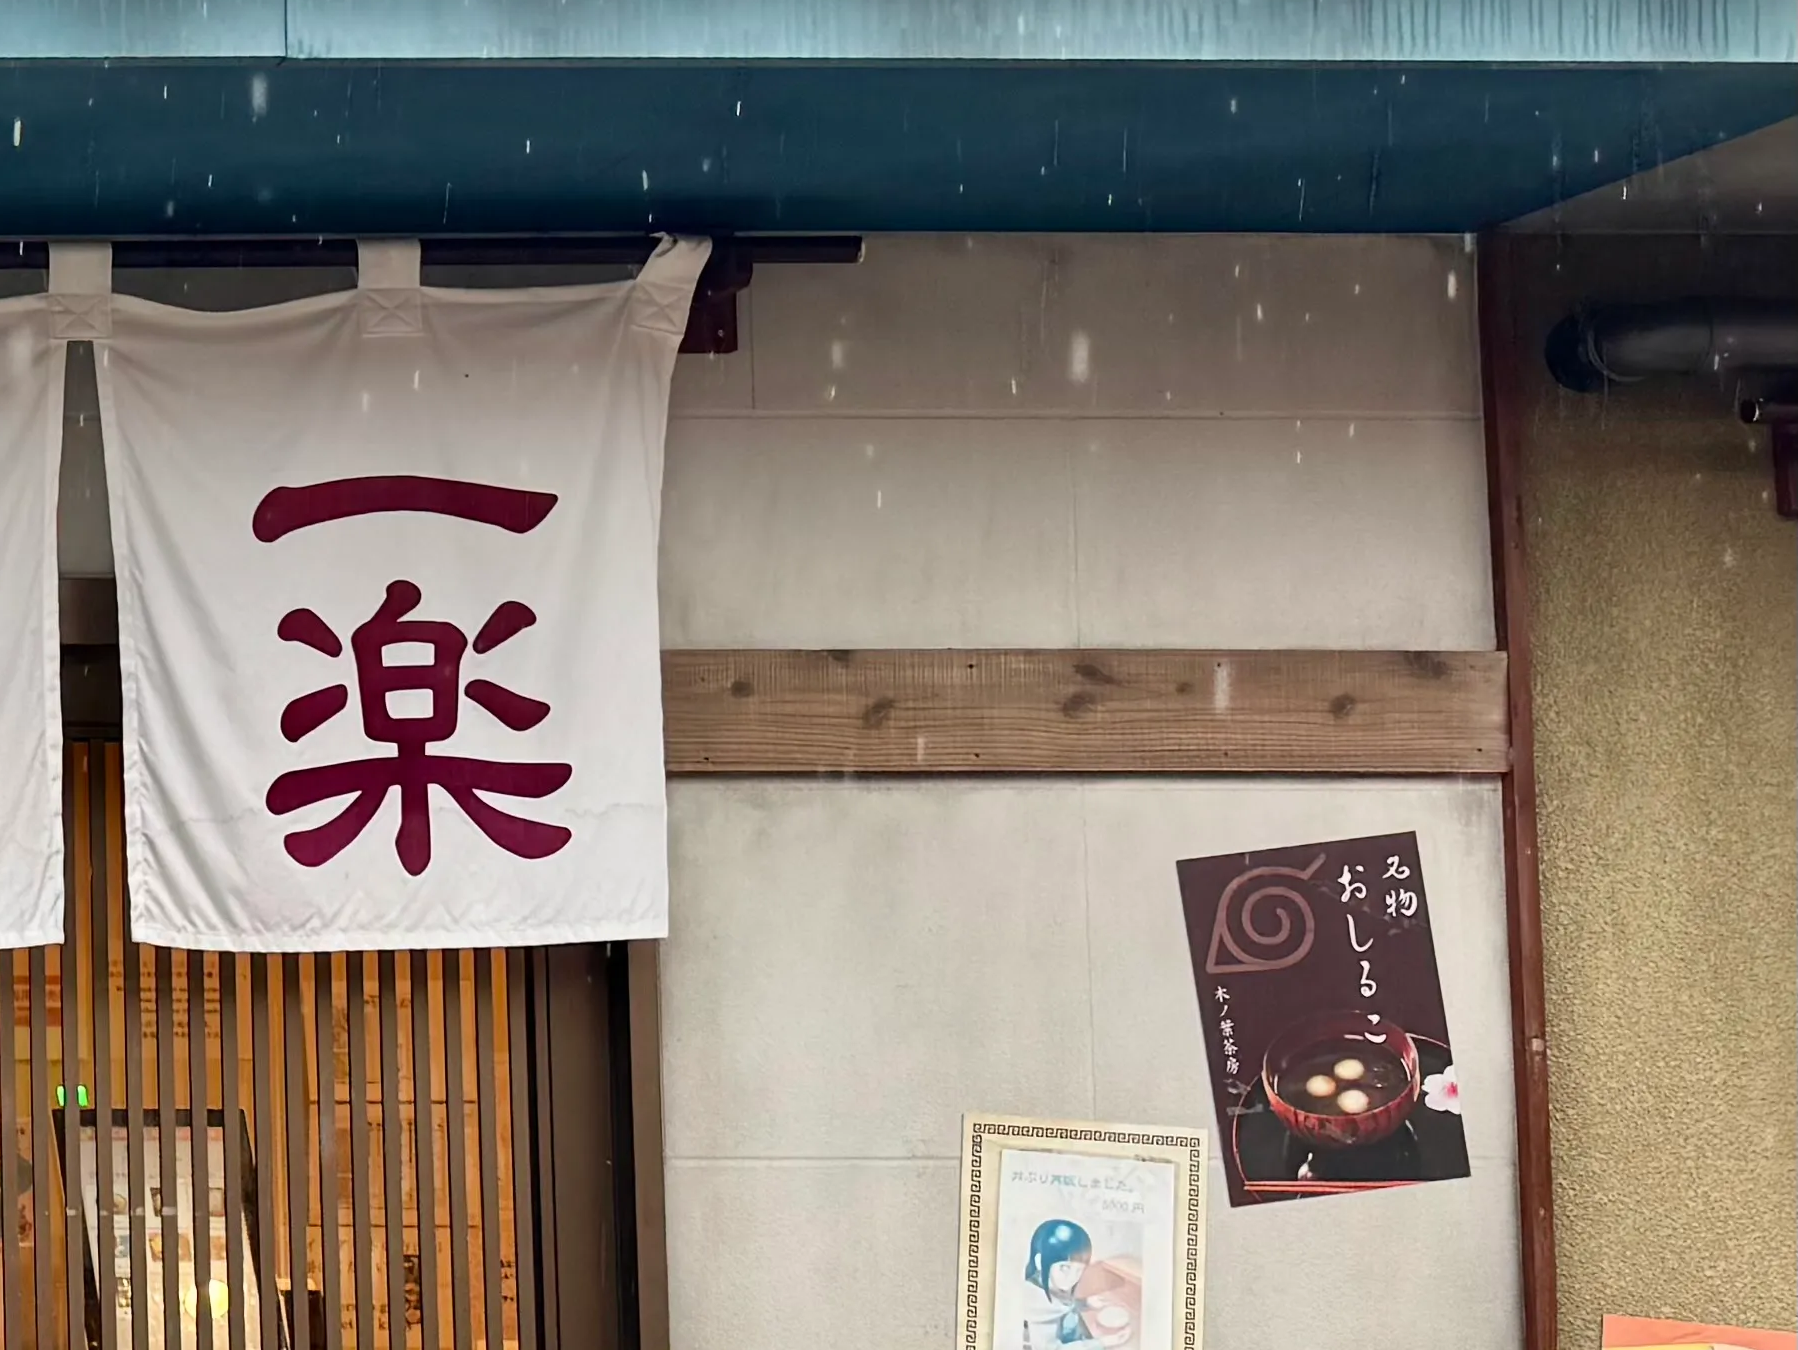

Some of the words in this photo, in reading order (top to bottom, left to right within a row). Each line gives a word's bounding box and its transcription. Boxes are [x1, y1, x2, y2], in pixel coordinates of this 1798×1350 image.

[252, 476, 573, 875] 一楽
[1382, 855, 1418, 917] 名物
[1337, 864, 1387, 1044] おしるこ
[1214, 985, 1240, 1075] 木ノ葉茶房
